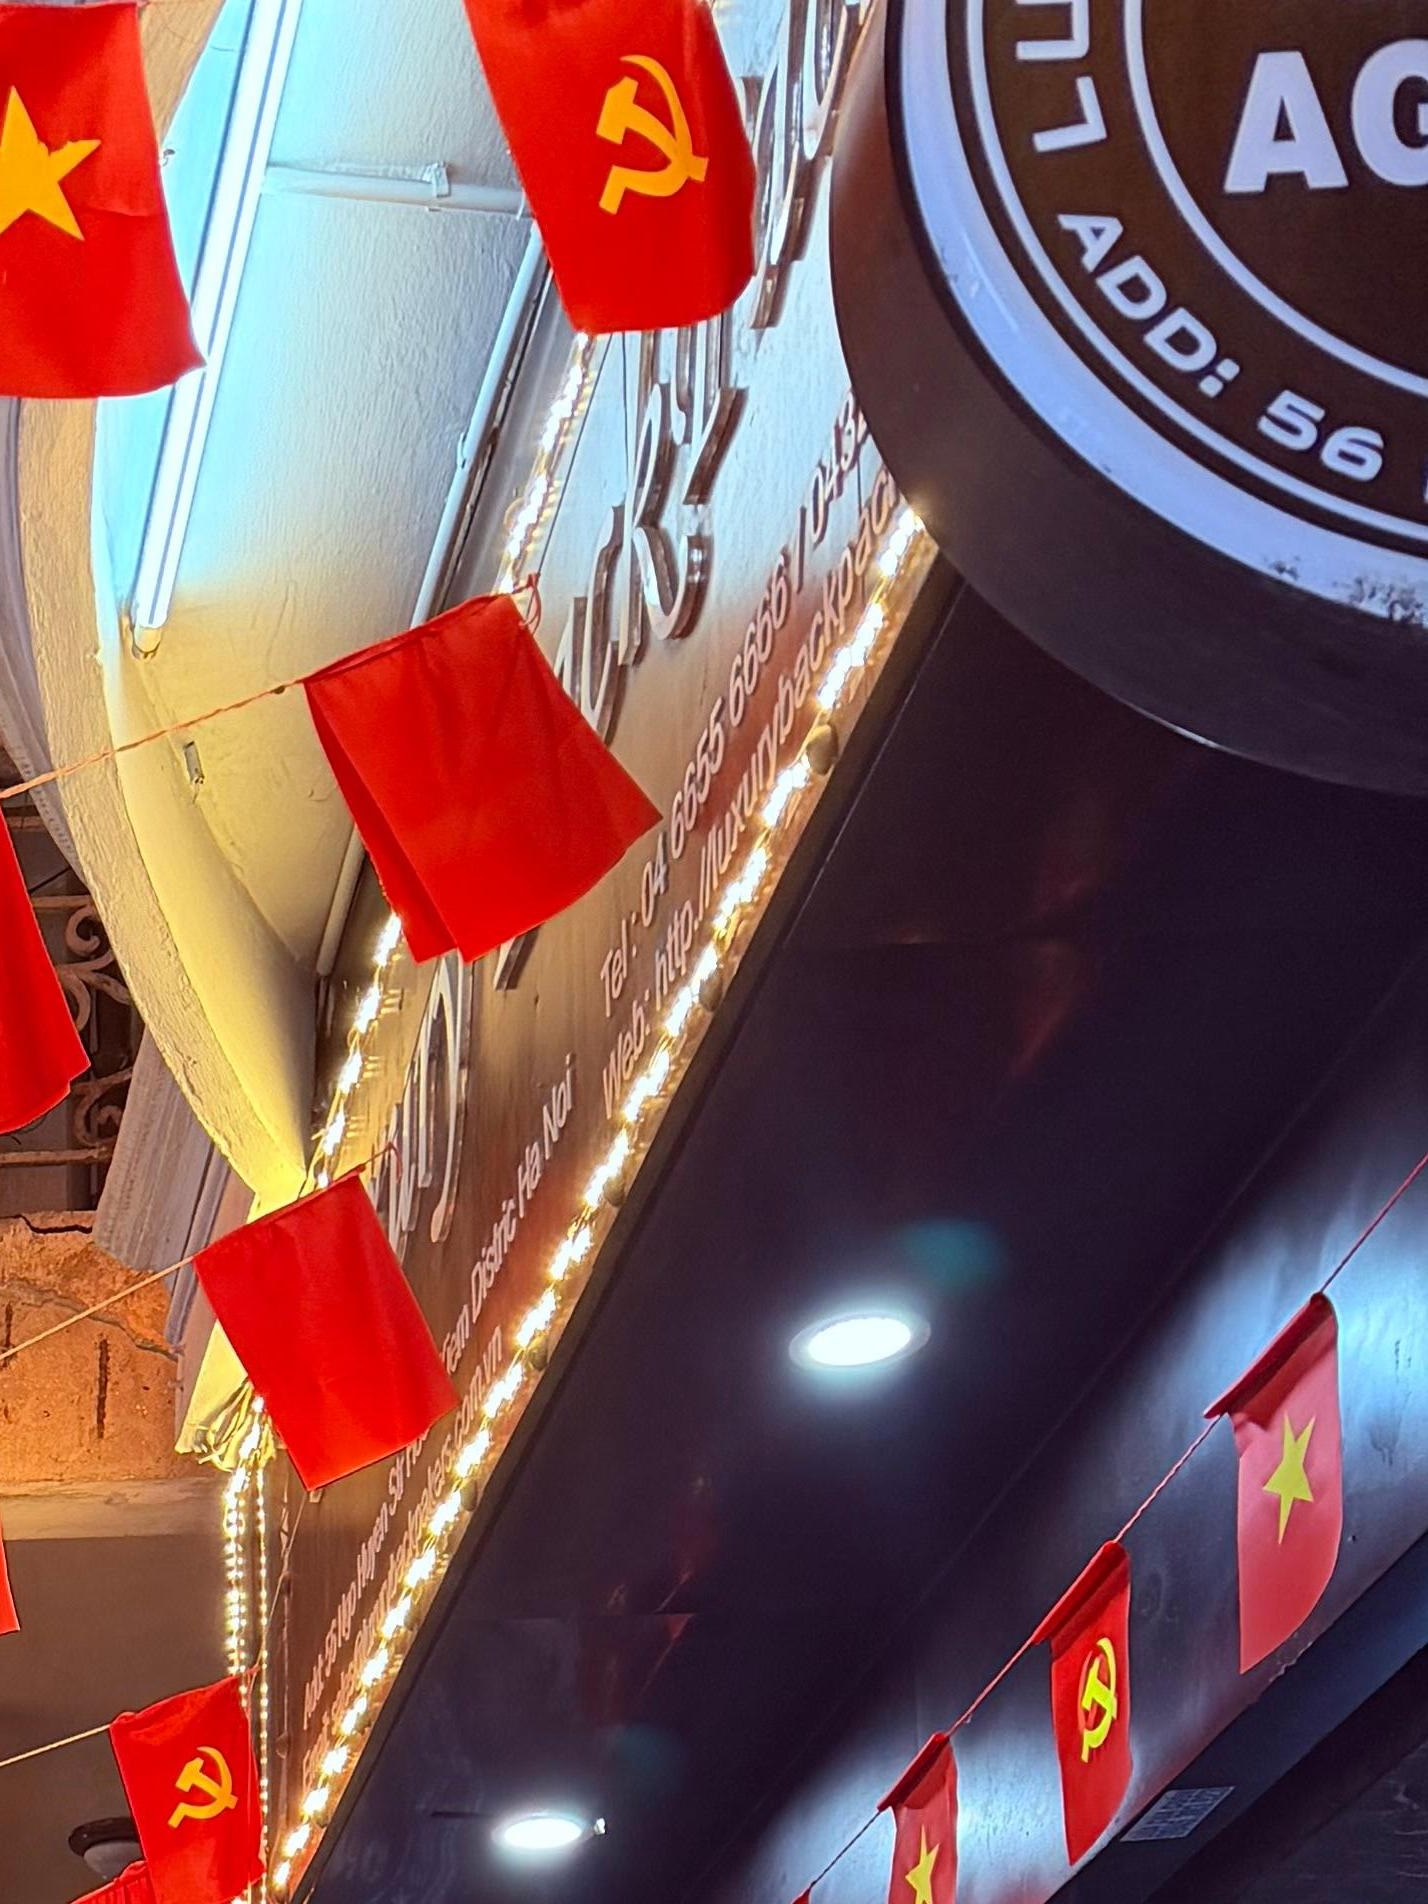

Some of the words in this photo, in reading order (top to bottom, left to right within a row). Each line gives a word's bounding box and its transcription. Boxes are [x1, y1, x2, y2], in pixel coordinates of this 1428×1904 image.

[1057, 213, 1241, 398] ADD:
[1257, 388, 1386, 483] 56
[669, 696, 727, 861] 6655
[728, 549, 790, 728] 6666
